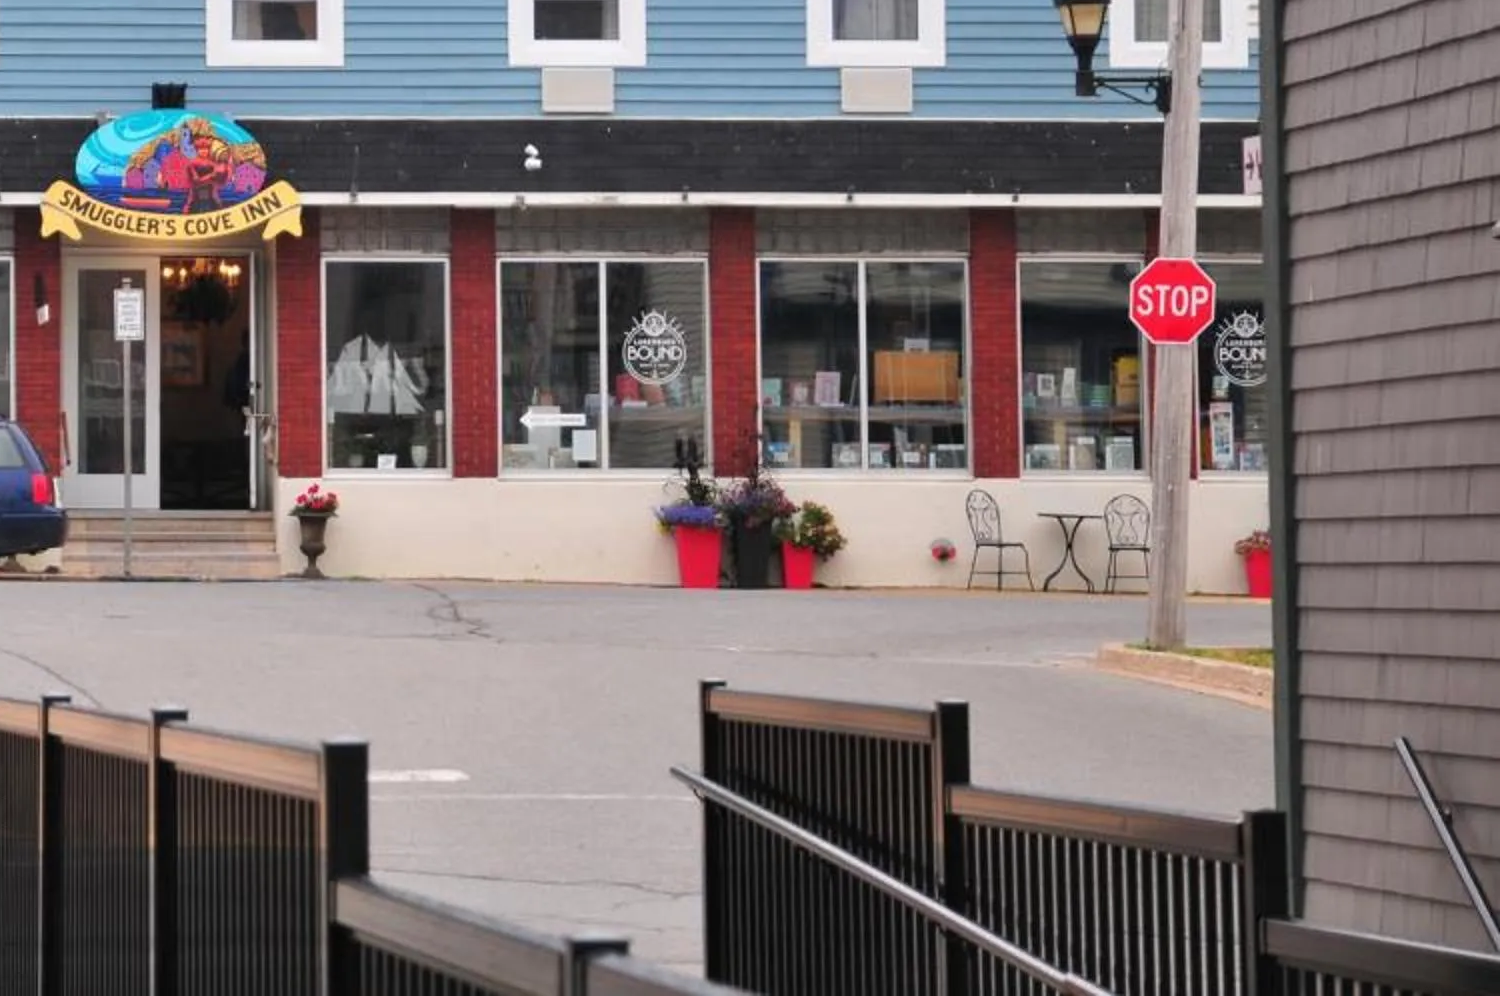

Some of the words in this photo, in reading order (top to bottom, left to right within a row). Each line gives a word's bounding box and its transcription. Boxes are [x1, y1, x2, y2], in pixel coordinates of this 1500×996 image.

[59, 190, 176, 236] SMUGGLER'S
[184, 212, 236, 236] COVE
[242, 191, 283, 223] INN
[1136, 284, 1209, 317] STOP
[627, 345, 683, 361] BOUND
[1219, 347, 1267, 361] BOUN
